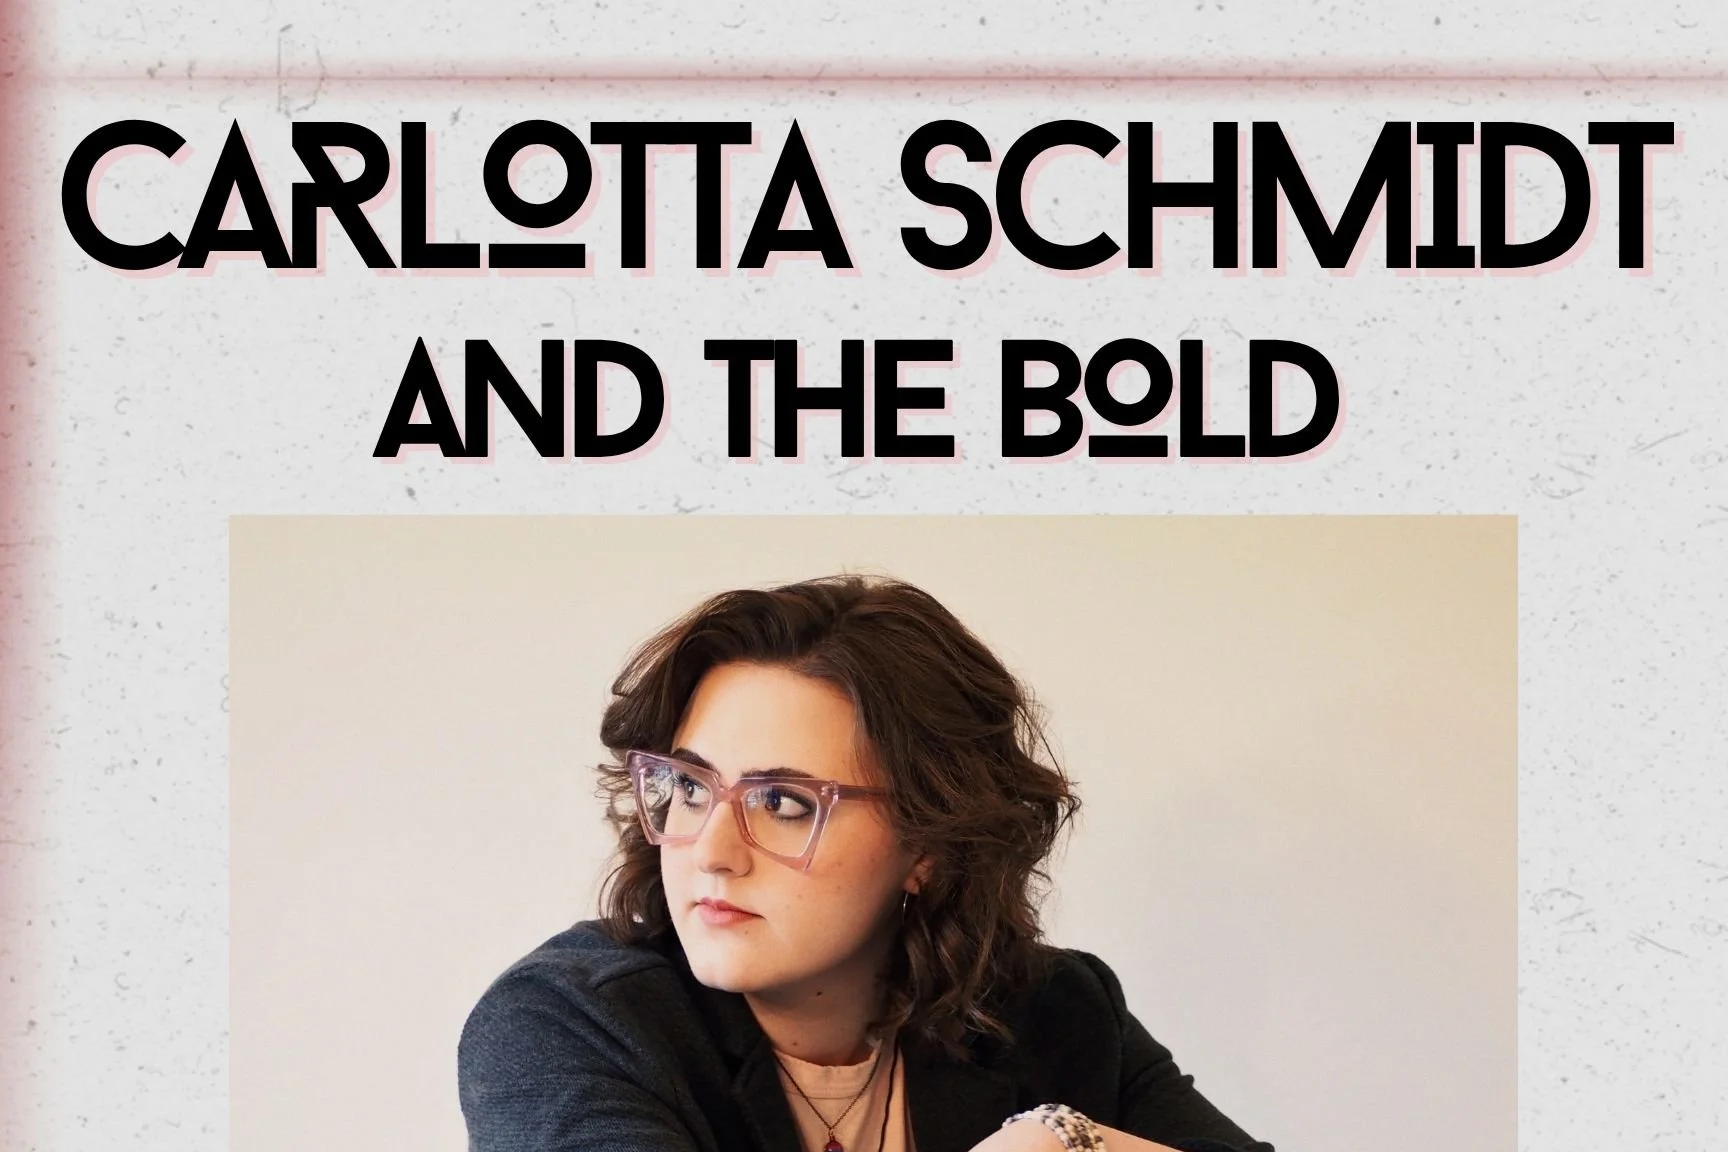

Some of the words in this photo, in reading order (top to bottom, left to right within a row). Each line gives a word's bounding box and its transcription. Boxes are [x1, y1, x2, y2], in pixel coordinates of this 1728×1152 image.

[62, 119, 853, 270] CARLOTTA
[901, 120, 1674, 270] SCHMIDT
[373, 337, 664, 457] AND
[704, 340, 954, 457] THE
[1002, 338, 1339, 457] BOLD
